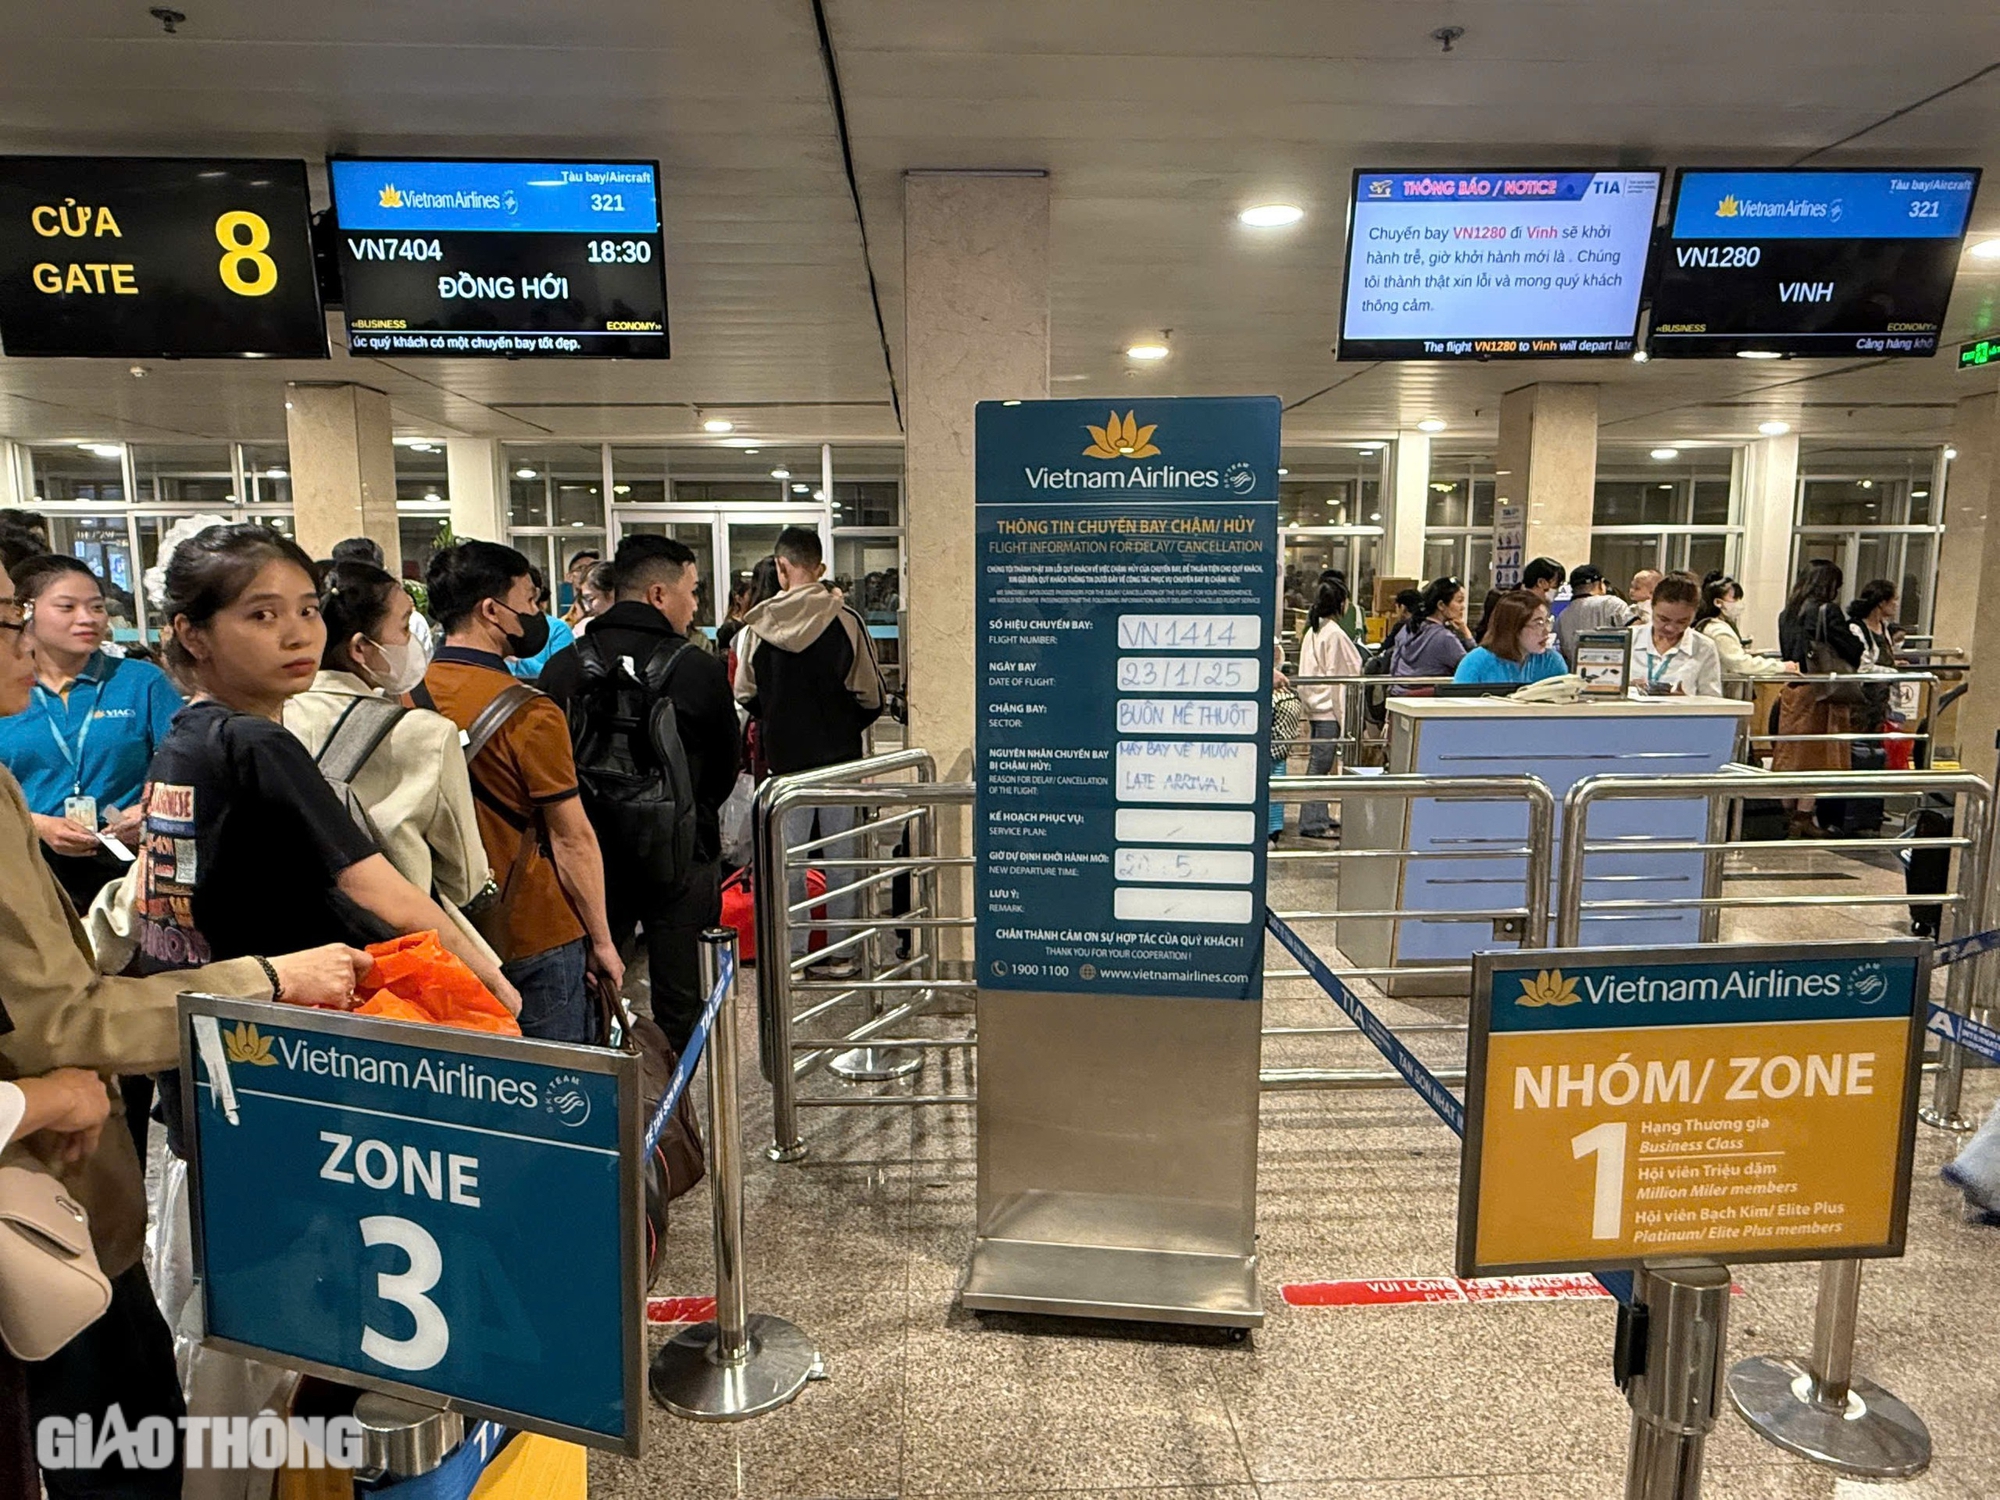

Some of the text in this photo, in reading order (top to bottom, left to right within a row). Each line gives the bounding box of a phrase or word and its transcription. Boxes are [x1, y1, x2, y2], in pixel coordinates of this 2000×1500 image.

[561, 171, 650, 184] Tàu bay/Aircraft
[1404, 176, 1454, 196] THÔNG
[1458, 175, 1489, 196] BÁO
[1504, 180, 1557, 196] NOTICE
[1593, 181, 1620, 194] TIA
[402, 190, 454, 208] Vietnam
[455, 191, 500, 210] Airlines
[591, 194, 625, 211] 321
[1737, 199, 1827, 217] Vietnam Airlines
[31, 198, 122, 237] CỬA
[1909, 201, 1939, 218] 321
[1369, 225, 1611, 243] Chuyến bay VN1280 đi Vinh sẽ khởi
[215, 210, 278, 296] 8
[348, 239, 442, 261] VN7404
[587, 241, 650, 263] 18:30
[1367, 251, 1400, 264] hành
[1429, 250, 1451, 268] giờ
[1454, 250, 1483, 264] khởi
[1487, 250, 1520, 264] hành
[1524, 250, 1549, 263] mới
[1553, 250, 1565, 263] là
[1578, 250, 1620, 266] Chúng
[1676, 246, 1760, 268] VN1280
[32, 263, 139, 294] GATE
[438, 271, 568, 299] ĐỒNG HỚI
[1365, 274, 1622, 291] tôi thành thật xin lỗi và mong quý khách
[1779, 282, 1834, 302] VINH
[1362, 299, 1398, 315] thông
[370, 337, 390, 350] quý
[393, 336, 427, 348] khách
[430, 337, 444, 348] có
[448, 338, 469, 350] một
[471, 337, 512, 350] chuyến
[514, 338, 535, 351] bay
[538, 338, 553, 349] tốt
[555, 338, 580, 351] đẹp.
[1424, 341, 1443, 352] The
[1447, 341, 1472, 354] flight
[1475, 341, 1516, 352] VN1280
[1519, 342, 1529, 351] to
[1532, 341, 1557, 351] Vinh
[1560, 341, 1576, 351] will
[1578, 340, 1612, 353] depart
[1025, 466, 1219, 489] Vietnam Airlines
[997, 516, 1048, 534] THÔNG
[1051, 520, 1074, 533] TIN
[1077, 514, 1136, 533] CHUYẾN
[1141, 520, 1167, 532] BAY
[1224, 514, 1255, 532] HỦY
[989, 541, 1027, 553] FLIGHT
[1030, 541, 1107, 553] INFORMATION
[1110, 541, 1130, 553] FOR
[1178, 540, 1263, 552] CANCELLATION
[989, 618, 1093, 630] SỐ HIỆU CHUYẾN BAY:
[989, 636, 1058, 645] FLIGHT NUMBER:
[989, 660, 1036, 672] NGÀY BAY
[989, 677, 1010, 686] DATE
[1013, 678, 1023, 686] OF
[1025, 704, 1047, 714] BAY:
[989, 748, 1108, 760] NGUYÊN NHÂN CHUYẾN BAY
[989, 827, 1021, 836] SERVICE
[989, 866, 1008, 874] NEW
[1010, 866, 1056, 875] DEPARTURE
[1012, 964, 1069, 976] 1900 1100
[1100, 968, 1248, 983] www.vietnamairlines.com
[1584, 970, 1841, 1004] Vietnam Airlines
[277, 1036, 538, 1108] Vietnam Airlines
[1514, 1052, 1875, 1110] NHÓM/ ZONE
[545, 1075, 580, 1114] SKYTEAM
[1642, 1117, 1769, 1136] Hạng Thương gia
[1640, 1137, 1743, 1154] Business Class
[320, 1130, 481, 1208] ZONE
[1638, 1162, 1776, 1180] Hội viên Triệu dặm
[1571, 1122, 1627, 1239] 1
[1637, 1181, 1798, 1200] Million Miler members
[1635, 1201, 1844, 1224] Hội viên Bạch Kim/ Elite Plus
[1634, 1221, 1843, 1243] Platinum/ Elite Plus members
[359, 1215, 450, 1371] 3
